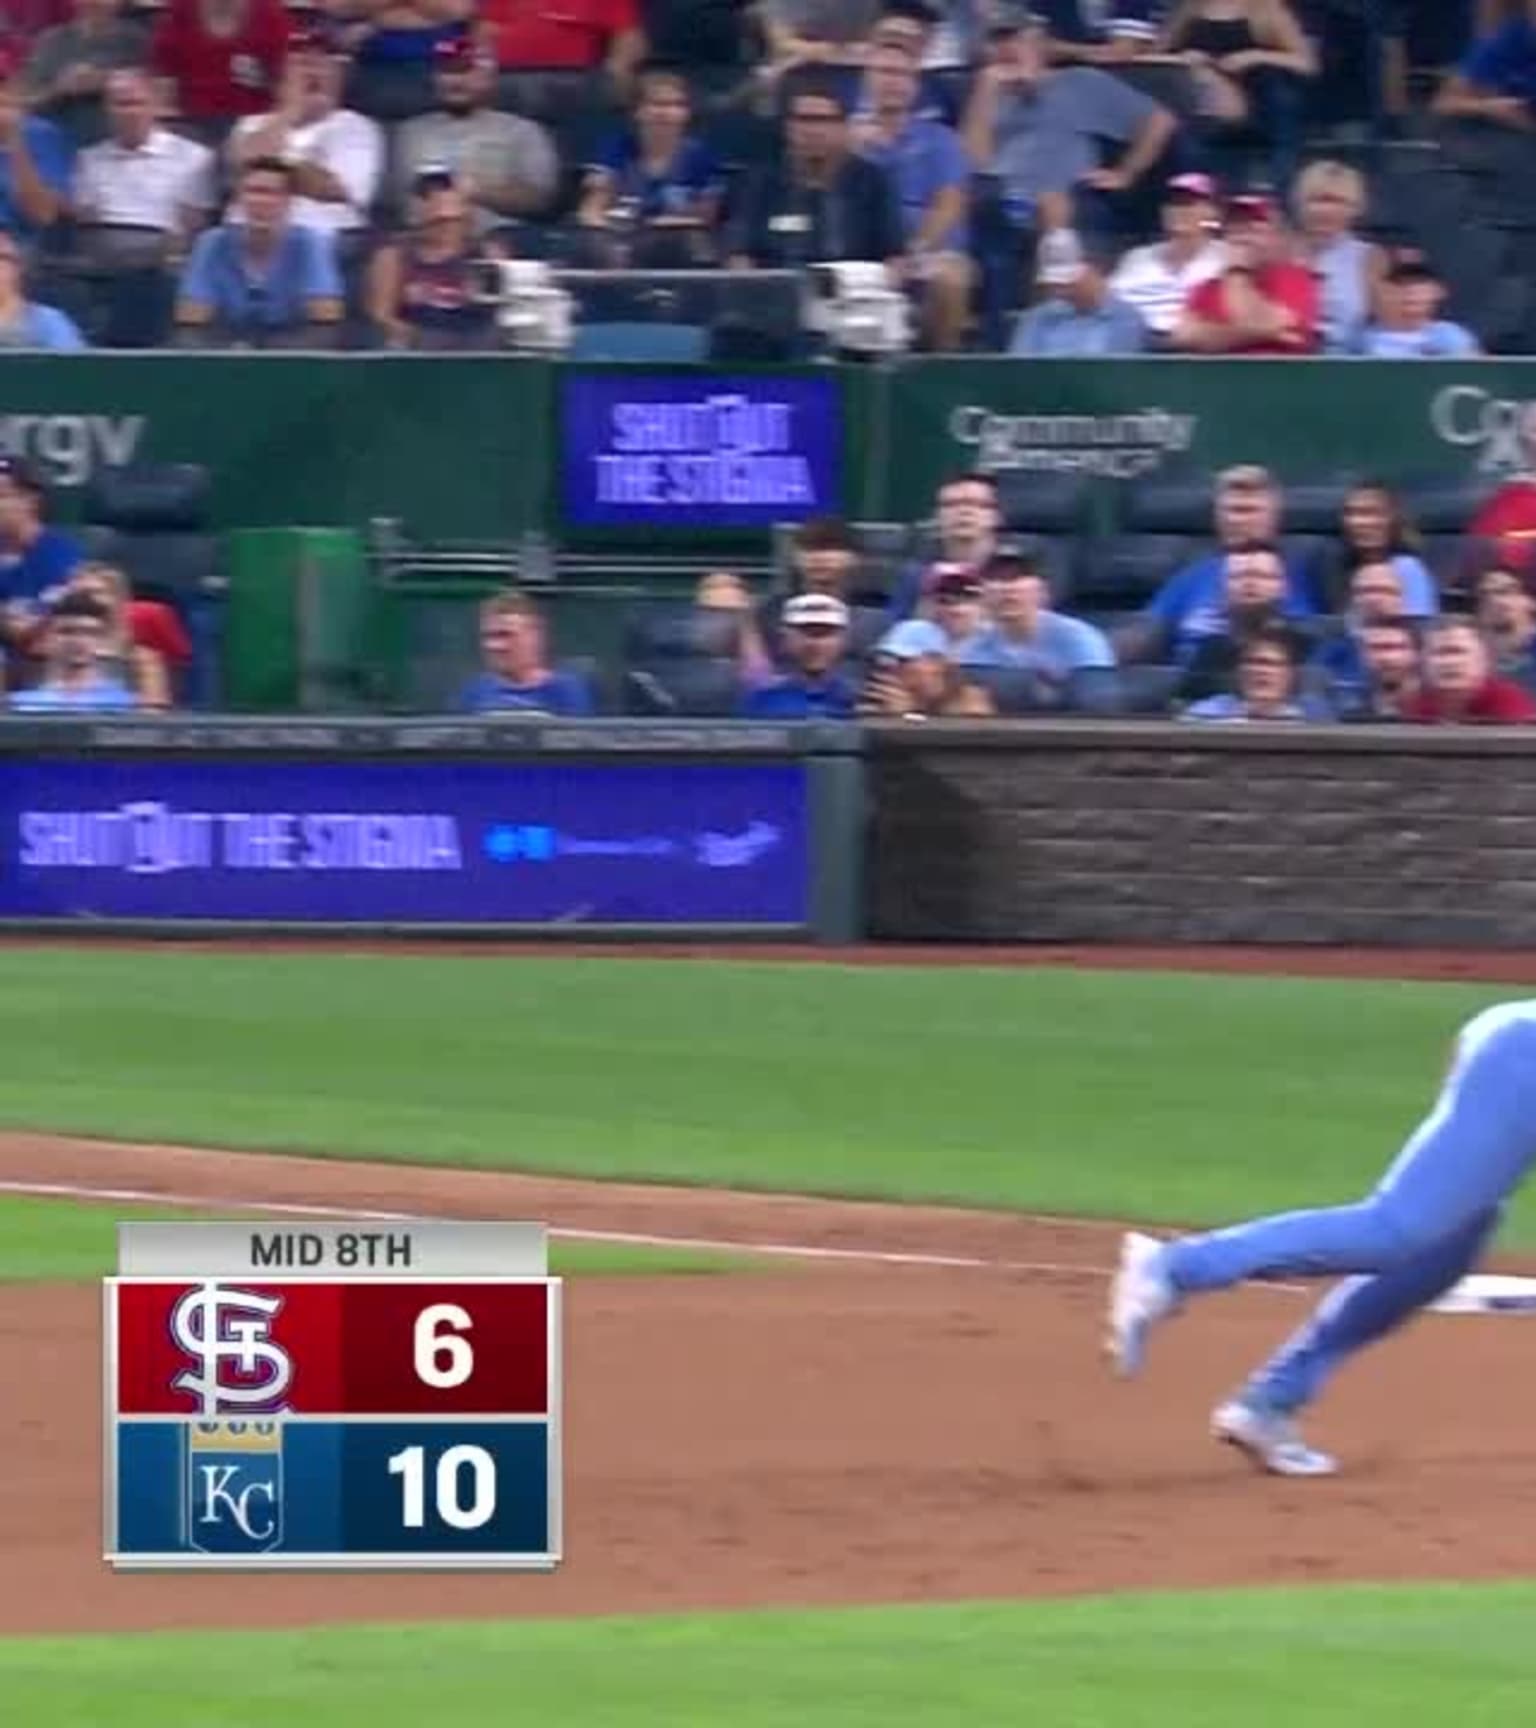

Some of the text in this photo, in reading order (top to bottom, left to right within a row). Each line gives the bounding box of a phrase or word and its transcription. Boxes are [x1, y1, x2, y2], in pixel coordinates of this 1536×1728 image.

[612, 402, 709, 451] SHUT
[949, 405, 1196, 450] Community
[592, 455, 816, 504] THE STIGMA
[18, 811, 129, 866] SHUT
[213, 812, 299, 868] THE
[300, 812, 462, 869] STIGMA
